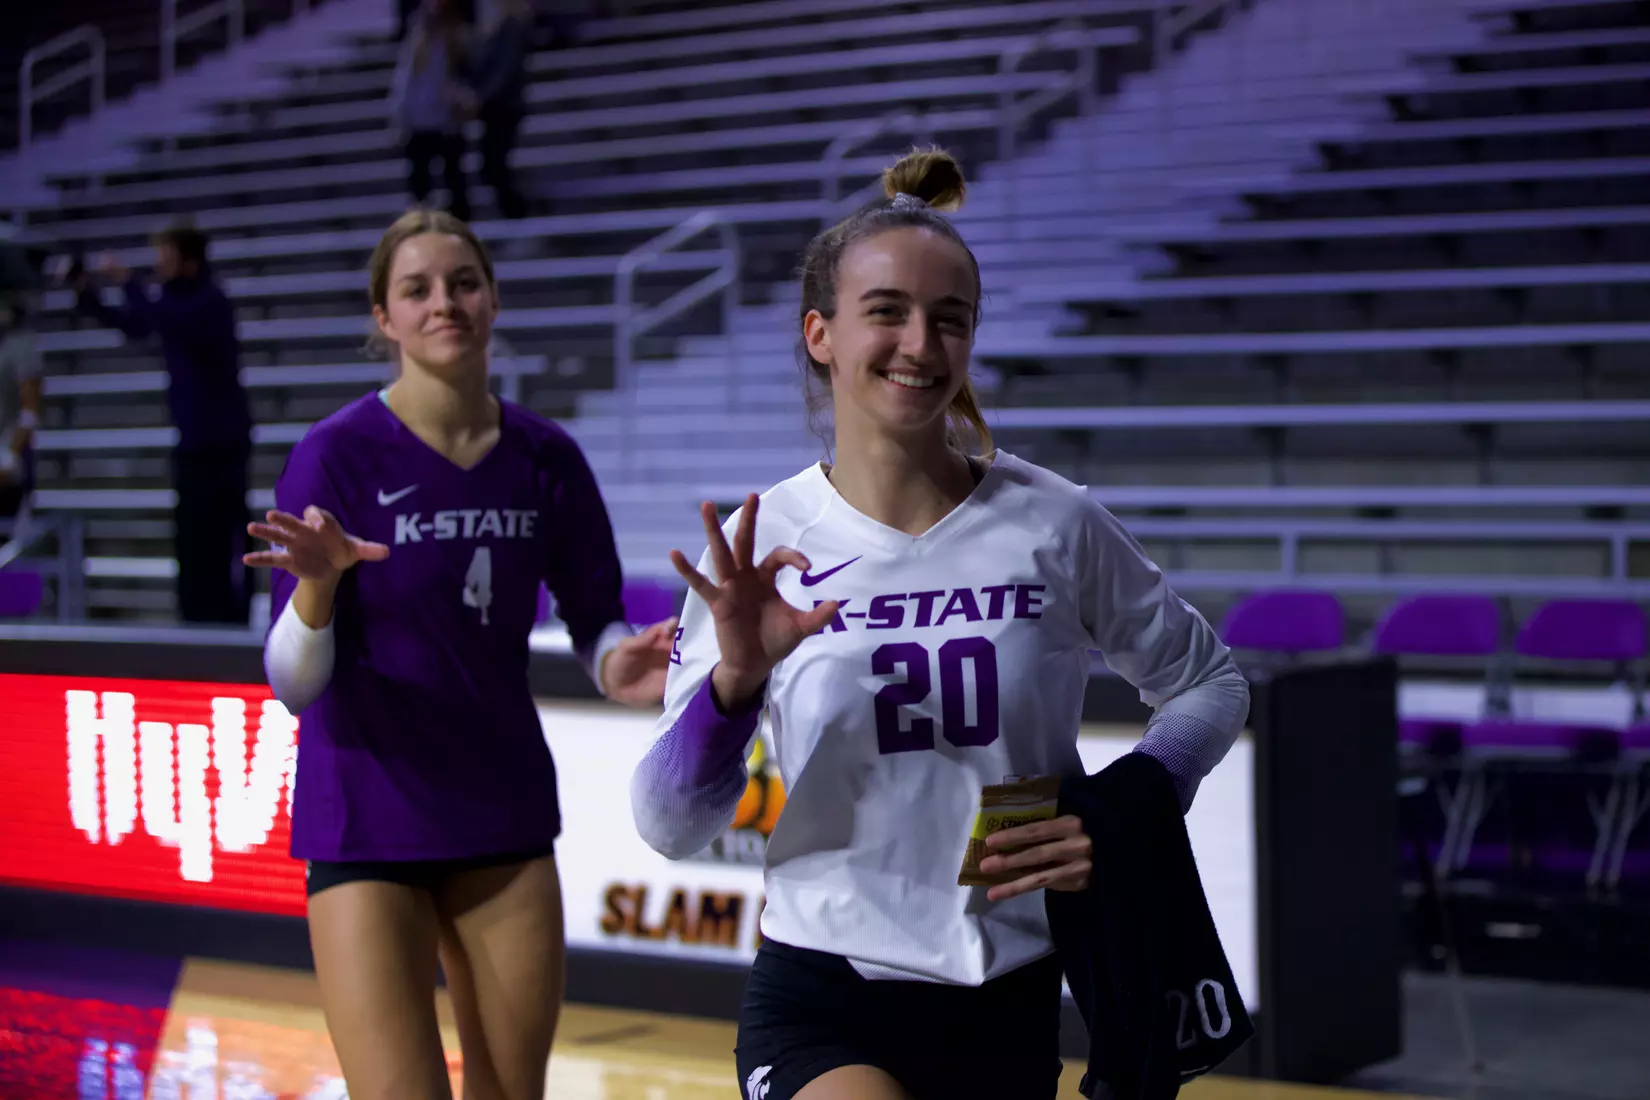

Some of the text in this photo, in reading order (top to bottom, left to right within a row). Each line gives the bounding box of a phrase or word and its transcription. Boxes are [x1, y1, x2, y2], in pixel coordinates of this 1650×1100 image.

[394, 509, 538, 545] K-STATE
[462, 546, 493, 625] 4
[871, 636, 999, 755] 20
[65, 689, 299, 882] HyV
[600, 882, 744, 948] SLAM
[1164, 978, 1232, 1050] 20
